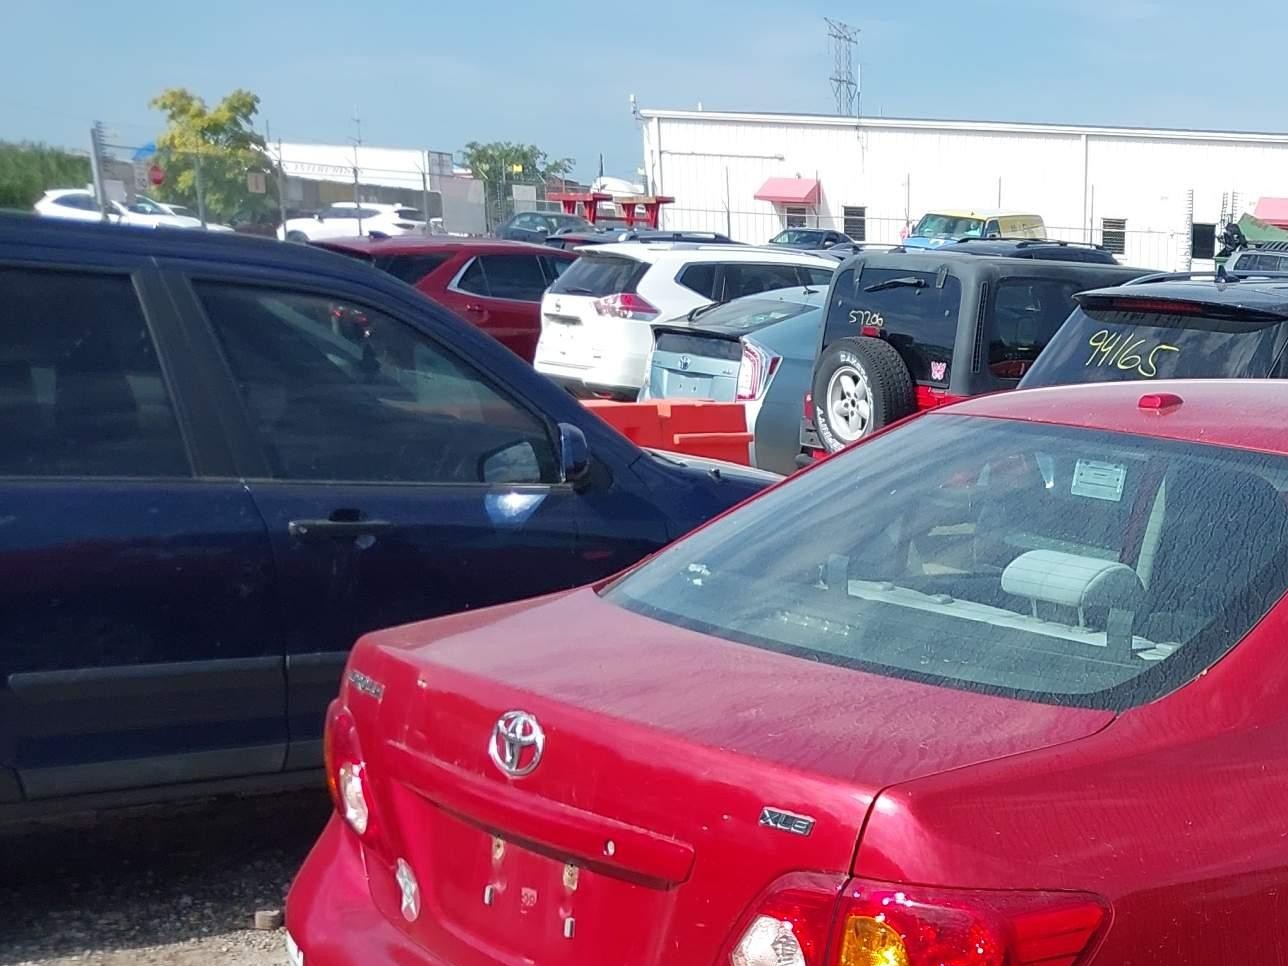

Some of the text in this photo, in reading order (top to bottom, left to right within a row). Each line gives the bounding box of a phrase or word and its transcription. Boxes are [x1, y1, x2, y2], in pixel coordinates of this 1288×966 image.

[849, 310, 884, 327] 57206
[1085, 329, 1180, 378] 94165
[760, 807, 814, 836] XLE
